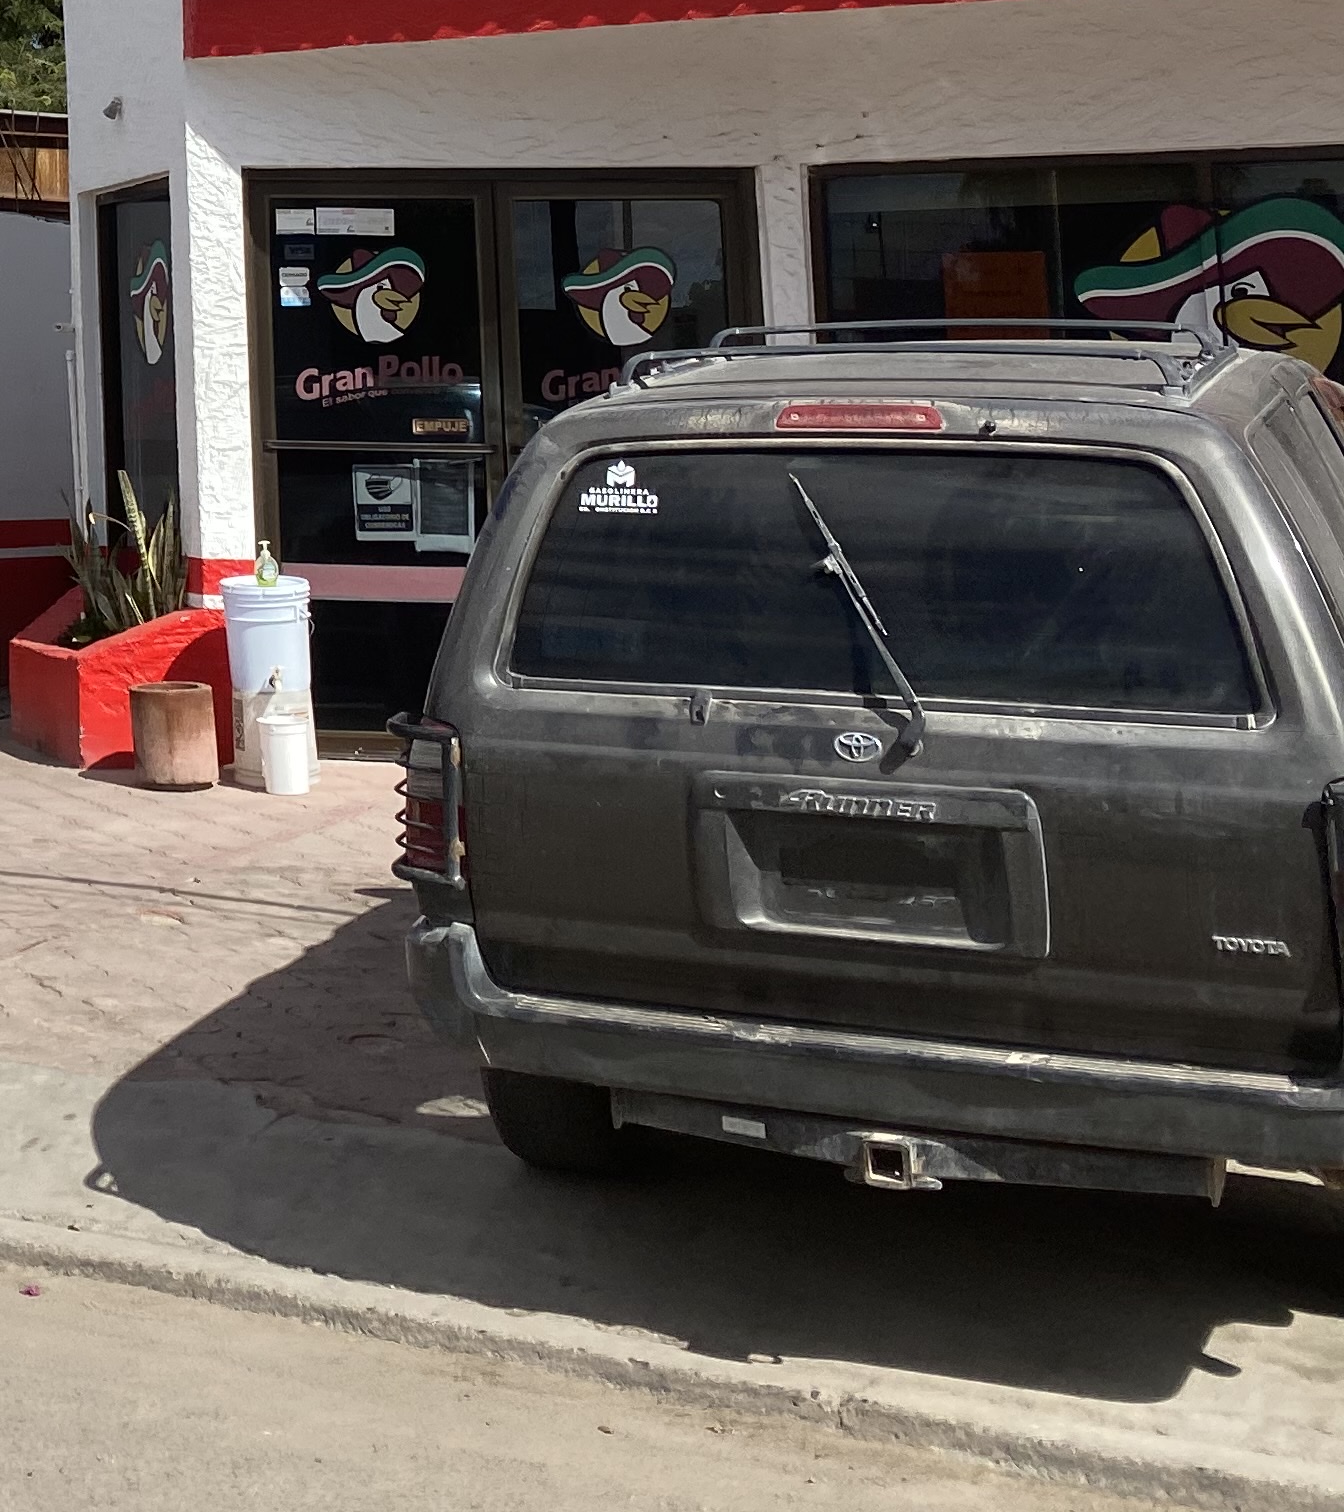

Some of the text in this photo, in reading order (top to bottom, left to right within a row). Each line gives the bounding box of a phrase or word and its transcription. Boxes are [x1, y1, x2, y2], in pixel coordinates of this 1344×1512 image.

[295, 354, 464, 401] Gran Pollo
[335, 390, 365, 404] sabor
[416, 420, 468, 433] EMPUJE
[580, 493, 659, 508] MURILLO
[1211, 935, 1292, 958] TOYOTA
